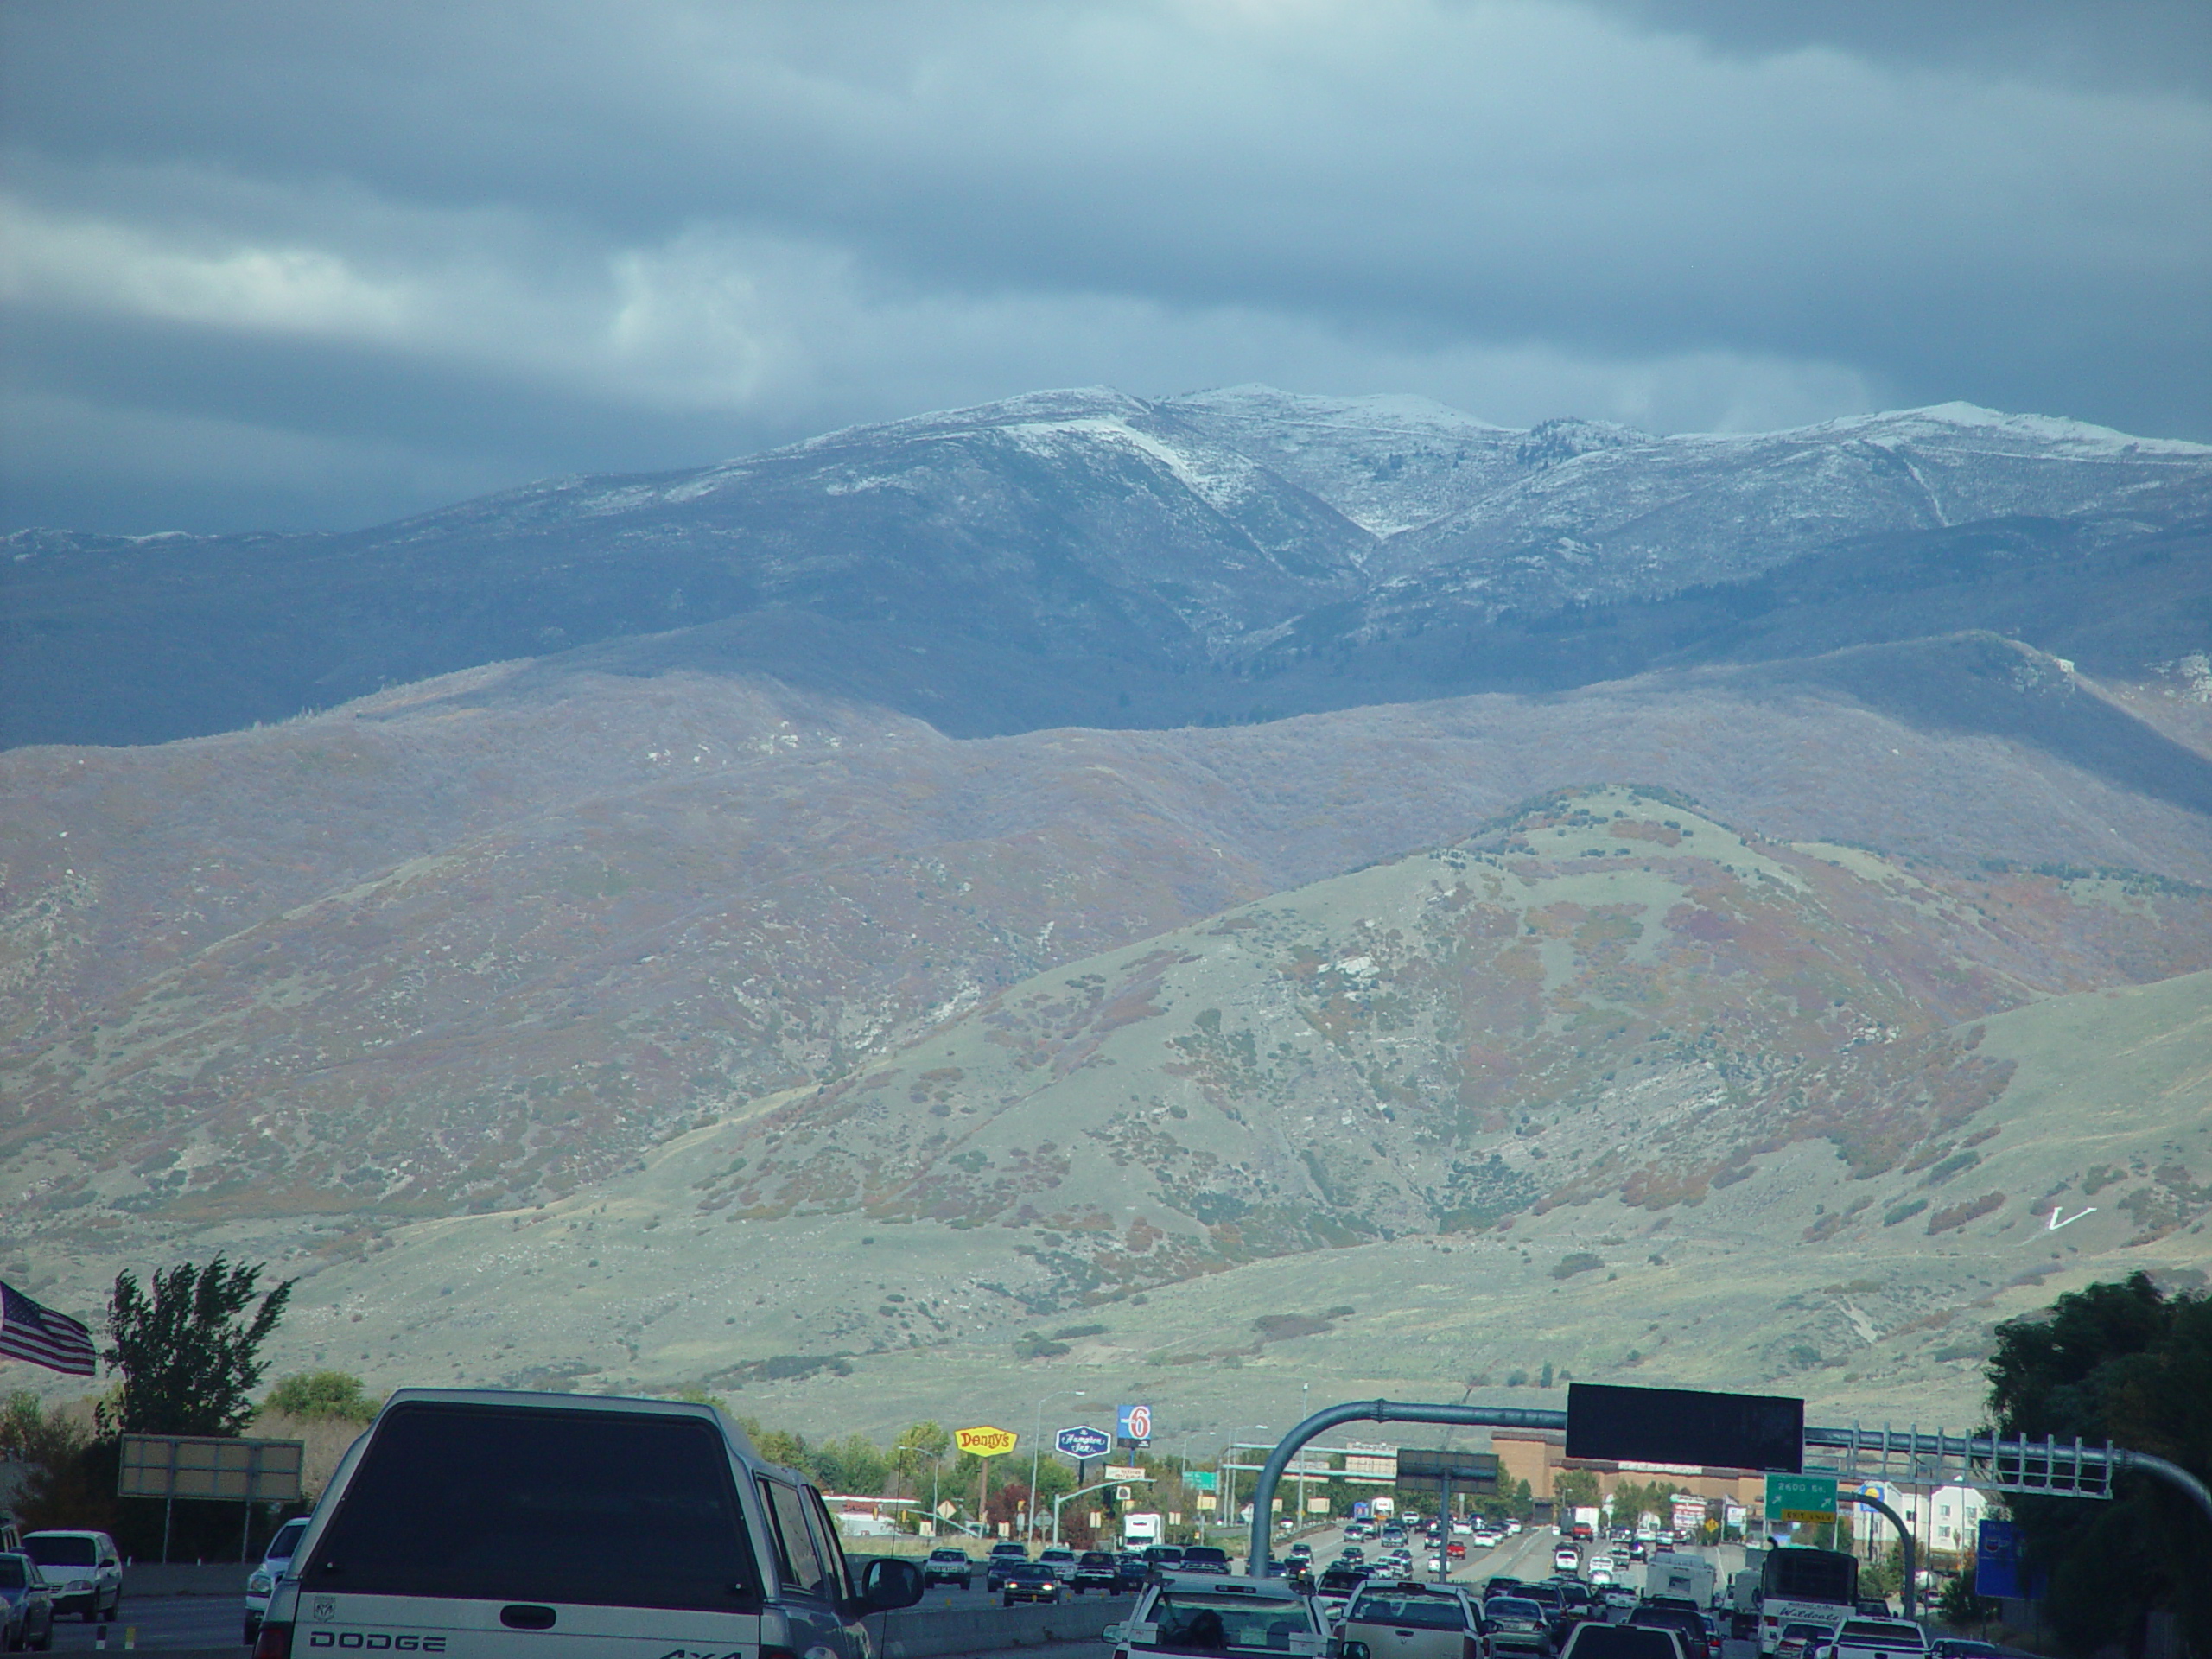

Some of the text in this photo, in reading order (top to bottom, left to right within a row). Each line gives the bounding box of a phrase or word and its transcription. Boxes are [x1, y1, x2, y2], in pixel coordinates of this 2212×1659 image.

[1128, 1406, 1151, 1440] 6
[960, 1432, 1009, 1449] Denny's
[1061, 1434, 1105, 1445] Hampton
[1777, 1482, 1806, 1492] 2600
[1780, 1607, 1839, 1621] Wildcats
[309, 1631, 447, 1653] DODGE
